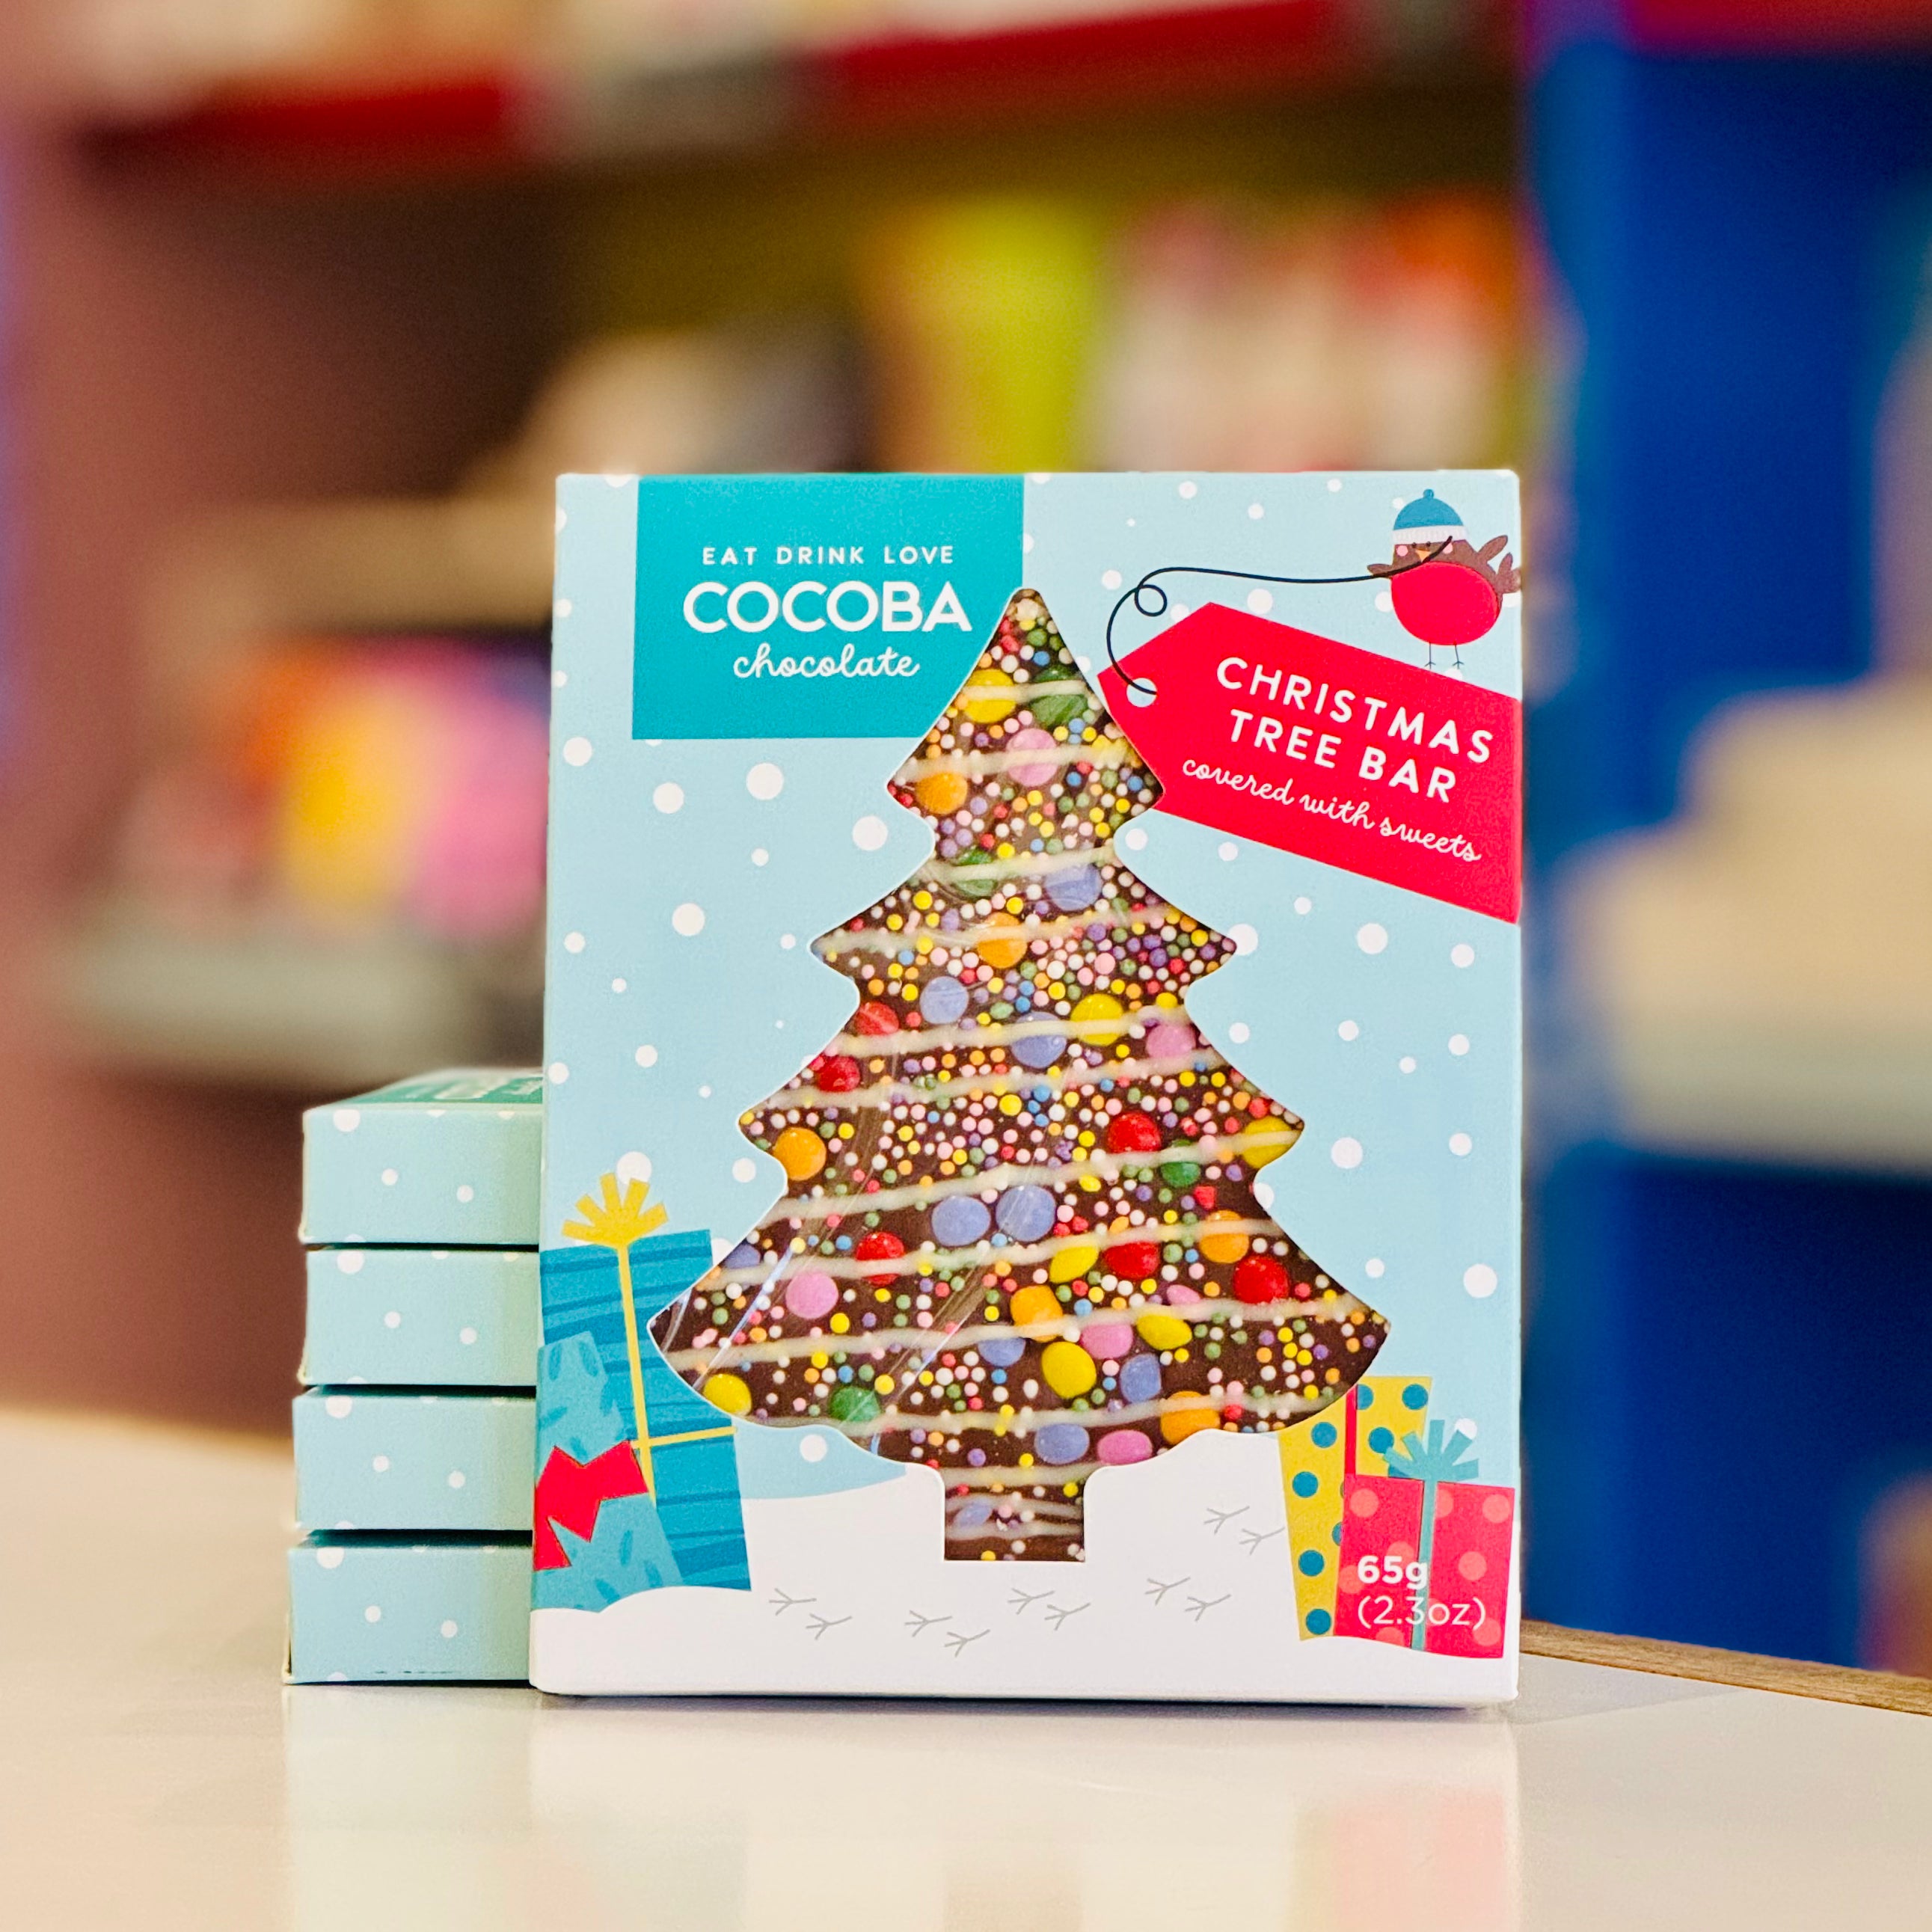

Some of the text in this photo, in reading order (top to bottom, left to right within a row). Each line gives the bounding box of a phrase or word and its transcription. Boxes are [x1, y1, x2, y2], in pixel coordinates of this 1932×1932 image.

[702, 545, 954, 566] EAT DRINK LOVE
[682, 580, 973, 634] COCOBA
[732, 642, 921, 679] chocolate
[1215, 655, 1494, 764] CHRISTMAS
[1228, 708, 1457, 803] TREE BAR
[1182, 758, 1483, 862] covered with sweets
[1357, 1554, 1429, 1591] 65g
[1357, 1595, 1487, 1631] (2.3oz)
